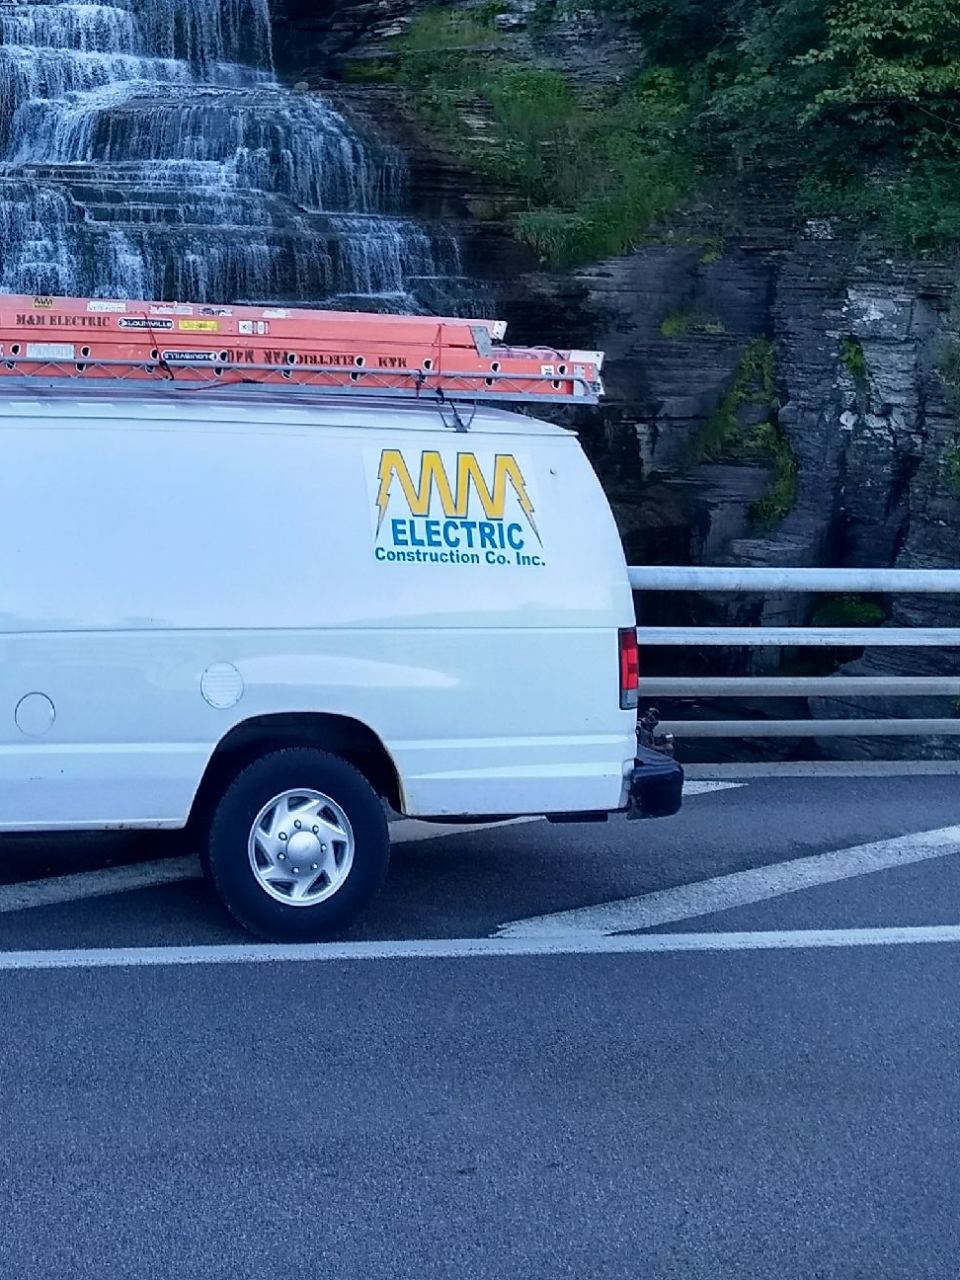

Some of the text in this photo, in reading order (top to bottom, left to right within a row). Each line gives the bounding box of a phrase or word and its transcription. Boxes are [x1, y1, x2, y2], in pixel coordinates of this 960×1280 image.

[16, 314, 46, 326] M&M
[49, 315, 112, 327] ELECTRIC
[295, 354, 407, 368] M&M ELECTRIC
[391, 519, 525, 550] ELECTRIC
[374, 547, 546, 566] Construction Co. Inc.
